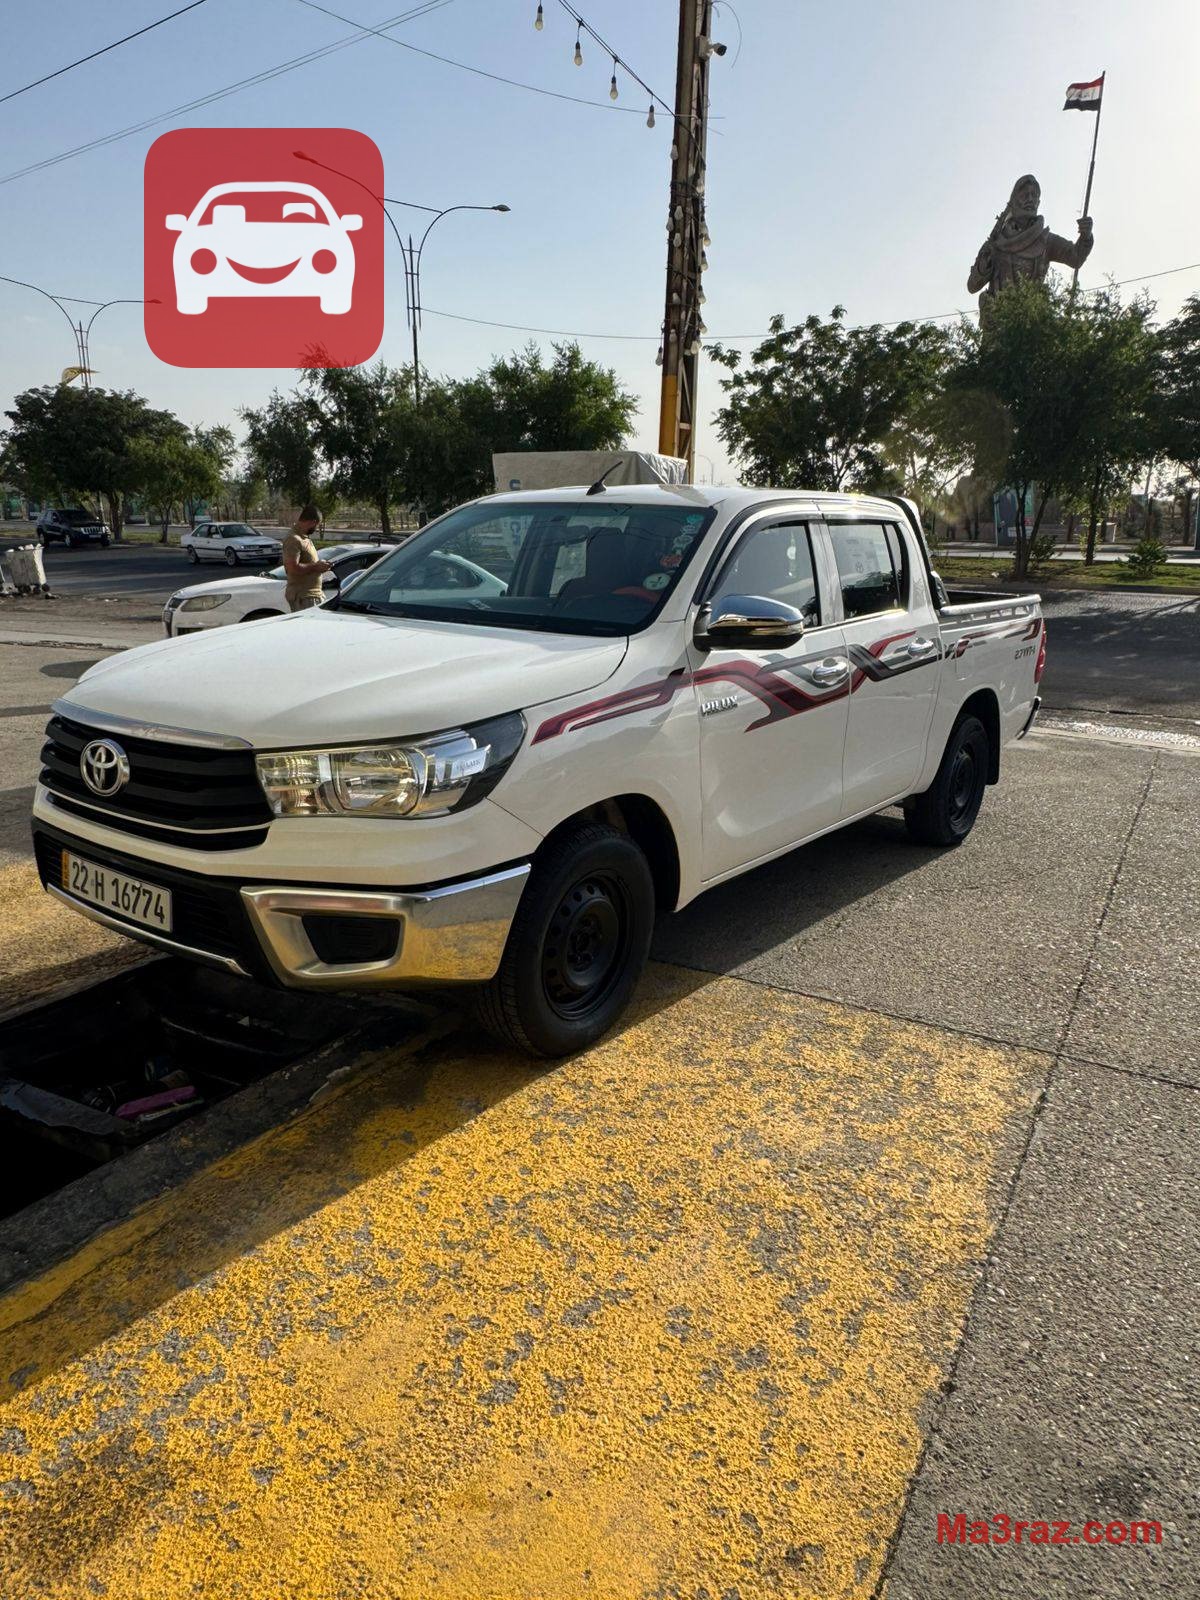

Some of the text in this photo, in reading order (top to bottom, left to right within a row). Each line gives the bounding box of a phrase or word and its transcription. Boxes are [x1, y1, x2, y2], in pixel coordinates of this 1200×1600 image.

[72, 861, 89, 895] 22
[95, 870, 105, 902] H
[111, 877, 165, 924] 16774
